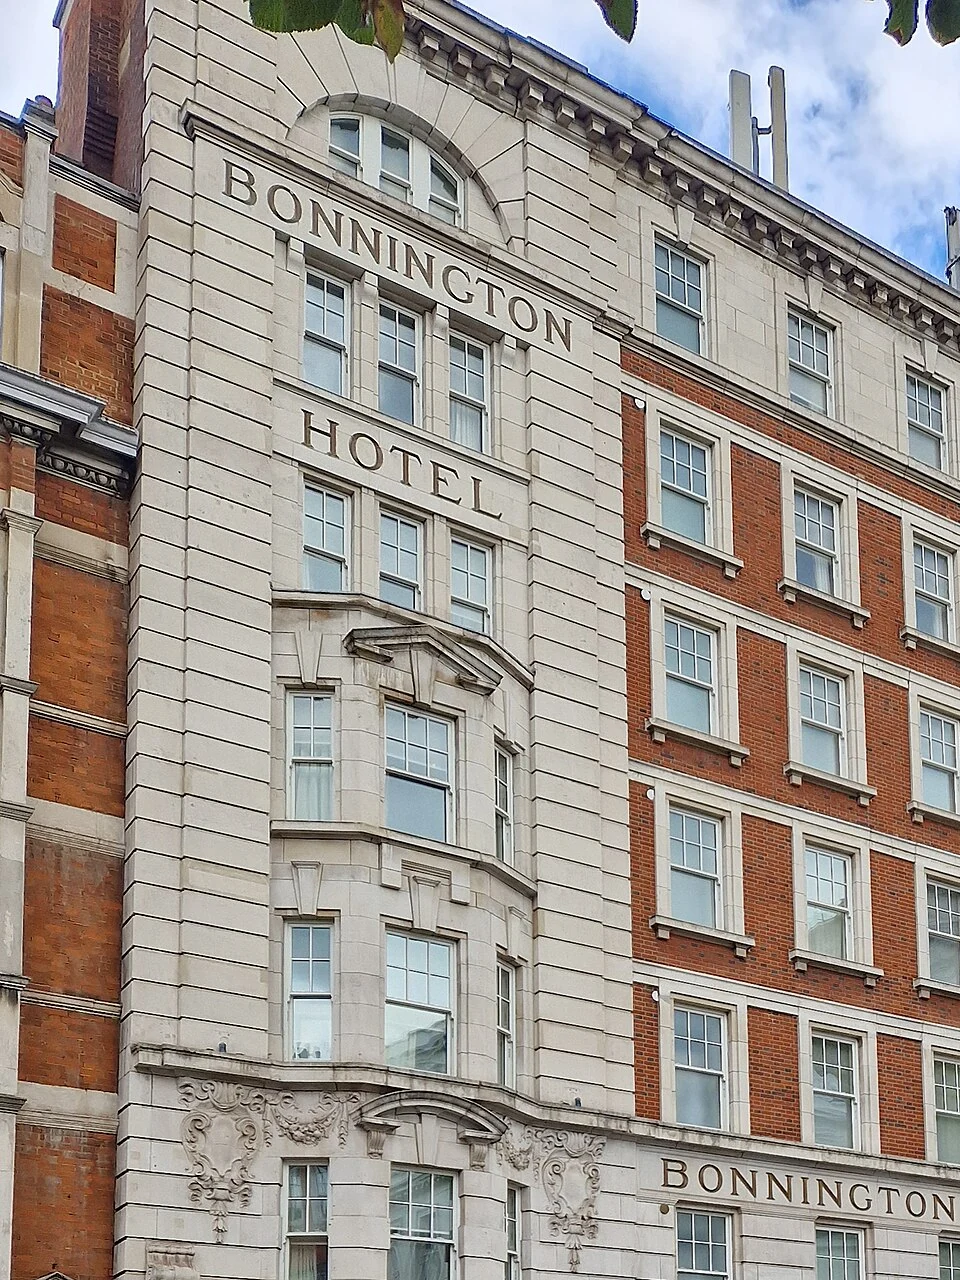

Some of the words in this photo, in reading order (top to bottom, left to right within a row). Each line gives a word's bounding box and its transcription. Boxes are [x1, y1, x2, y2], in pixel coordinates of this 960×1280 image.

[222, 158, 573, 353] BONNINGTON
[300, 409, 503, 520] HOTEL
[661, 1157, 957, 1222] BONNINGTON
